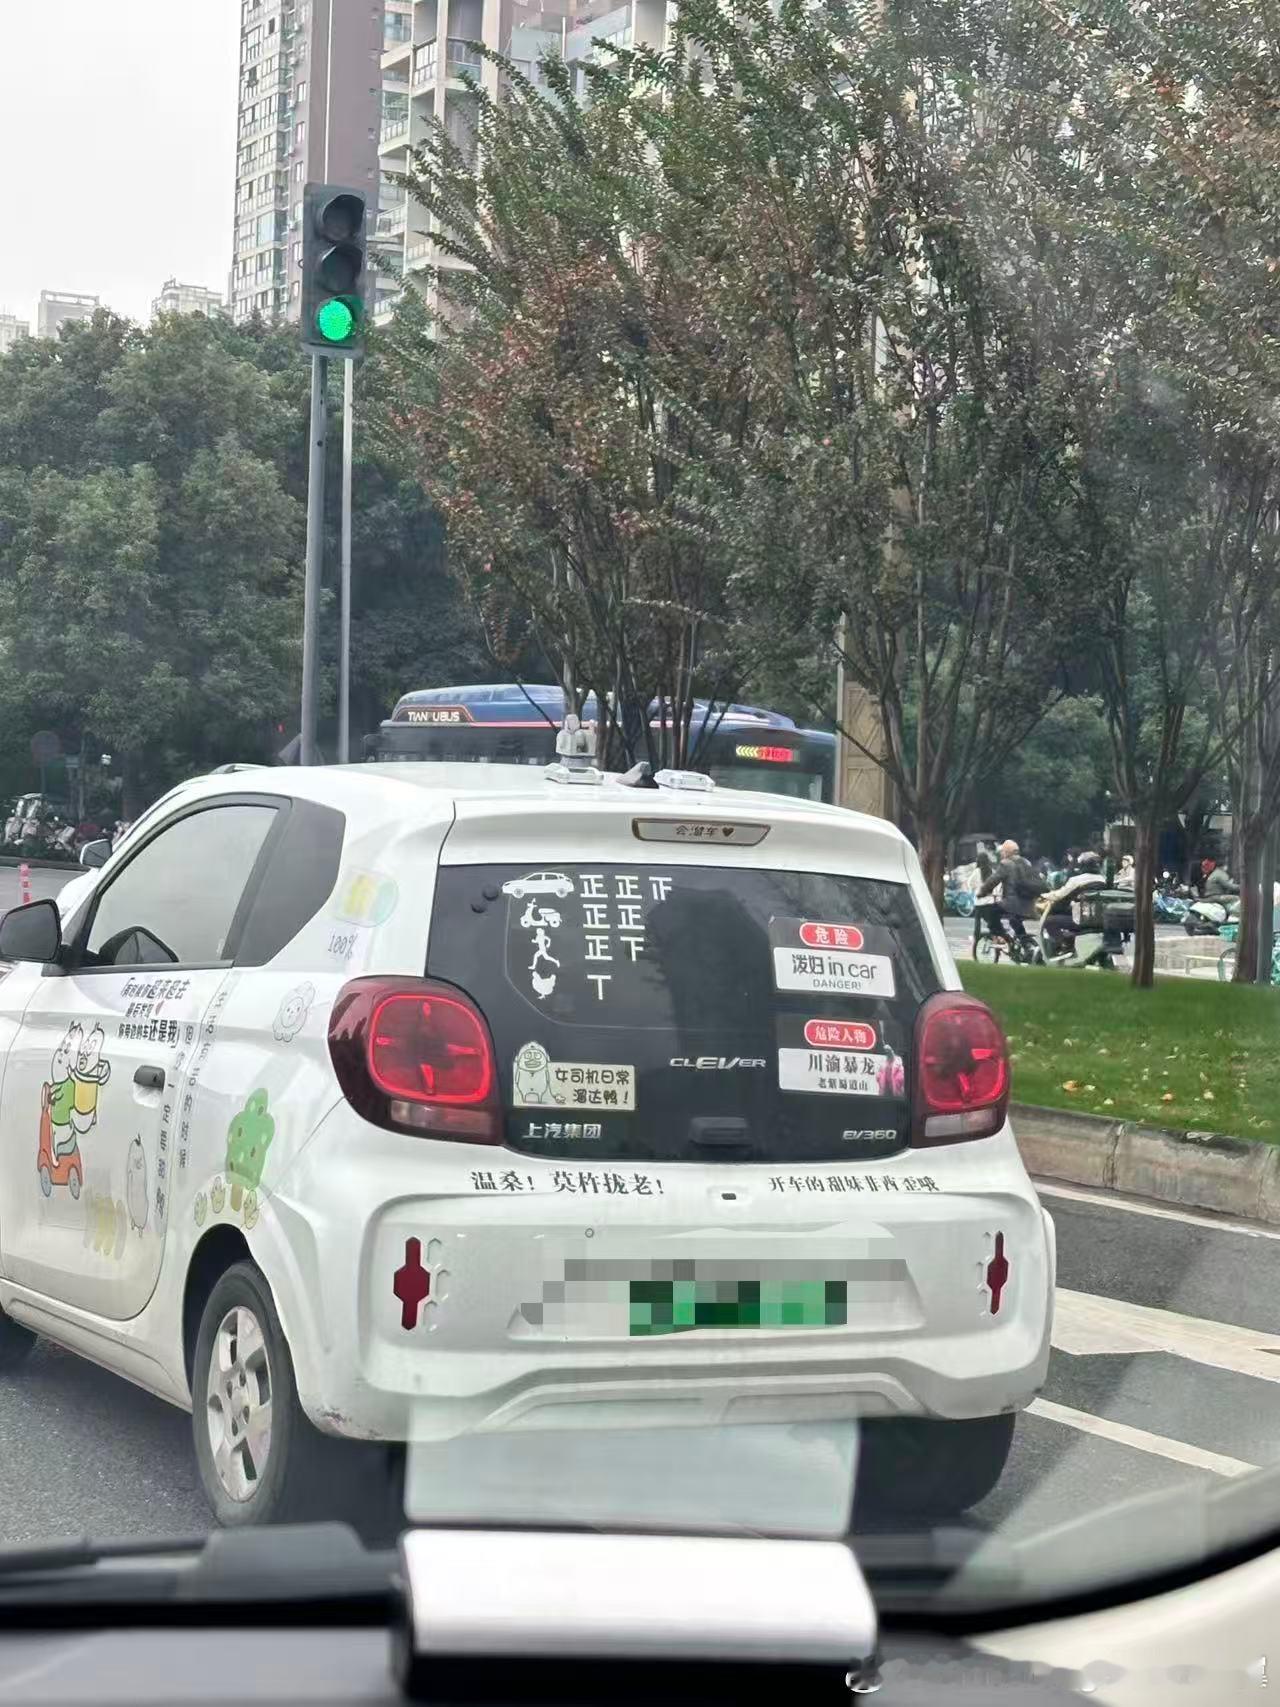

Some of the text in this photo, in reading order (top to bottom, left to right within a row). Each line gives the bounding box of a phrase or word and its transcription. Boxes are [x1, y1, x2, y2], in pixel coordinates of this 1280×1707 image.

[408, 711, 460, 722] TIANUBUS
[815, 926, 849, 945] 危险
[791, 953, 877, 980] 泼妇 in car
[813, 978, 861, 990] DANGER!
[815, 1025, 867, 1044] 危险人物
[669, 1057, 766, 1069] CLEVER
[808, 1054, 876, 1076] 川渝暴龙
[555, 1068, 630, 1085] 女司机日常
[522, 1122, 601, 1138] 上汽集团
[842, 1129, 897, 1141] EV360
